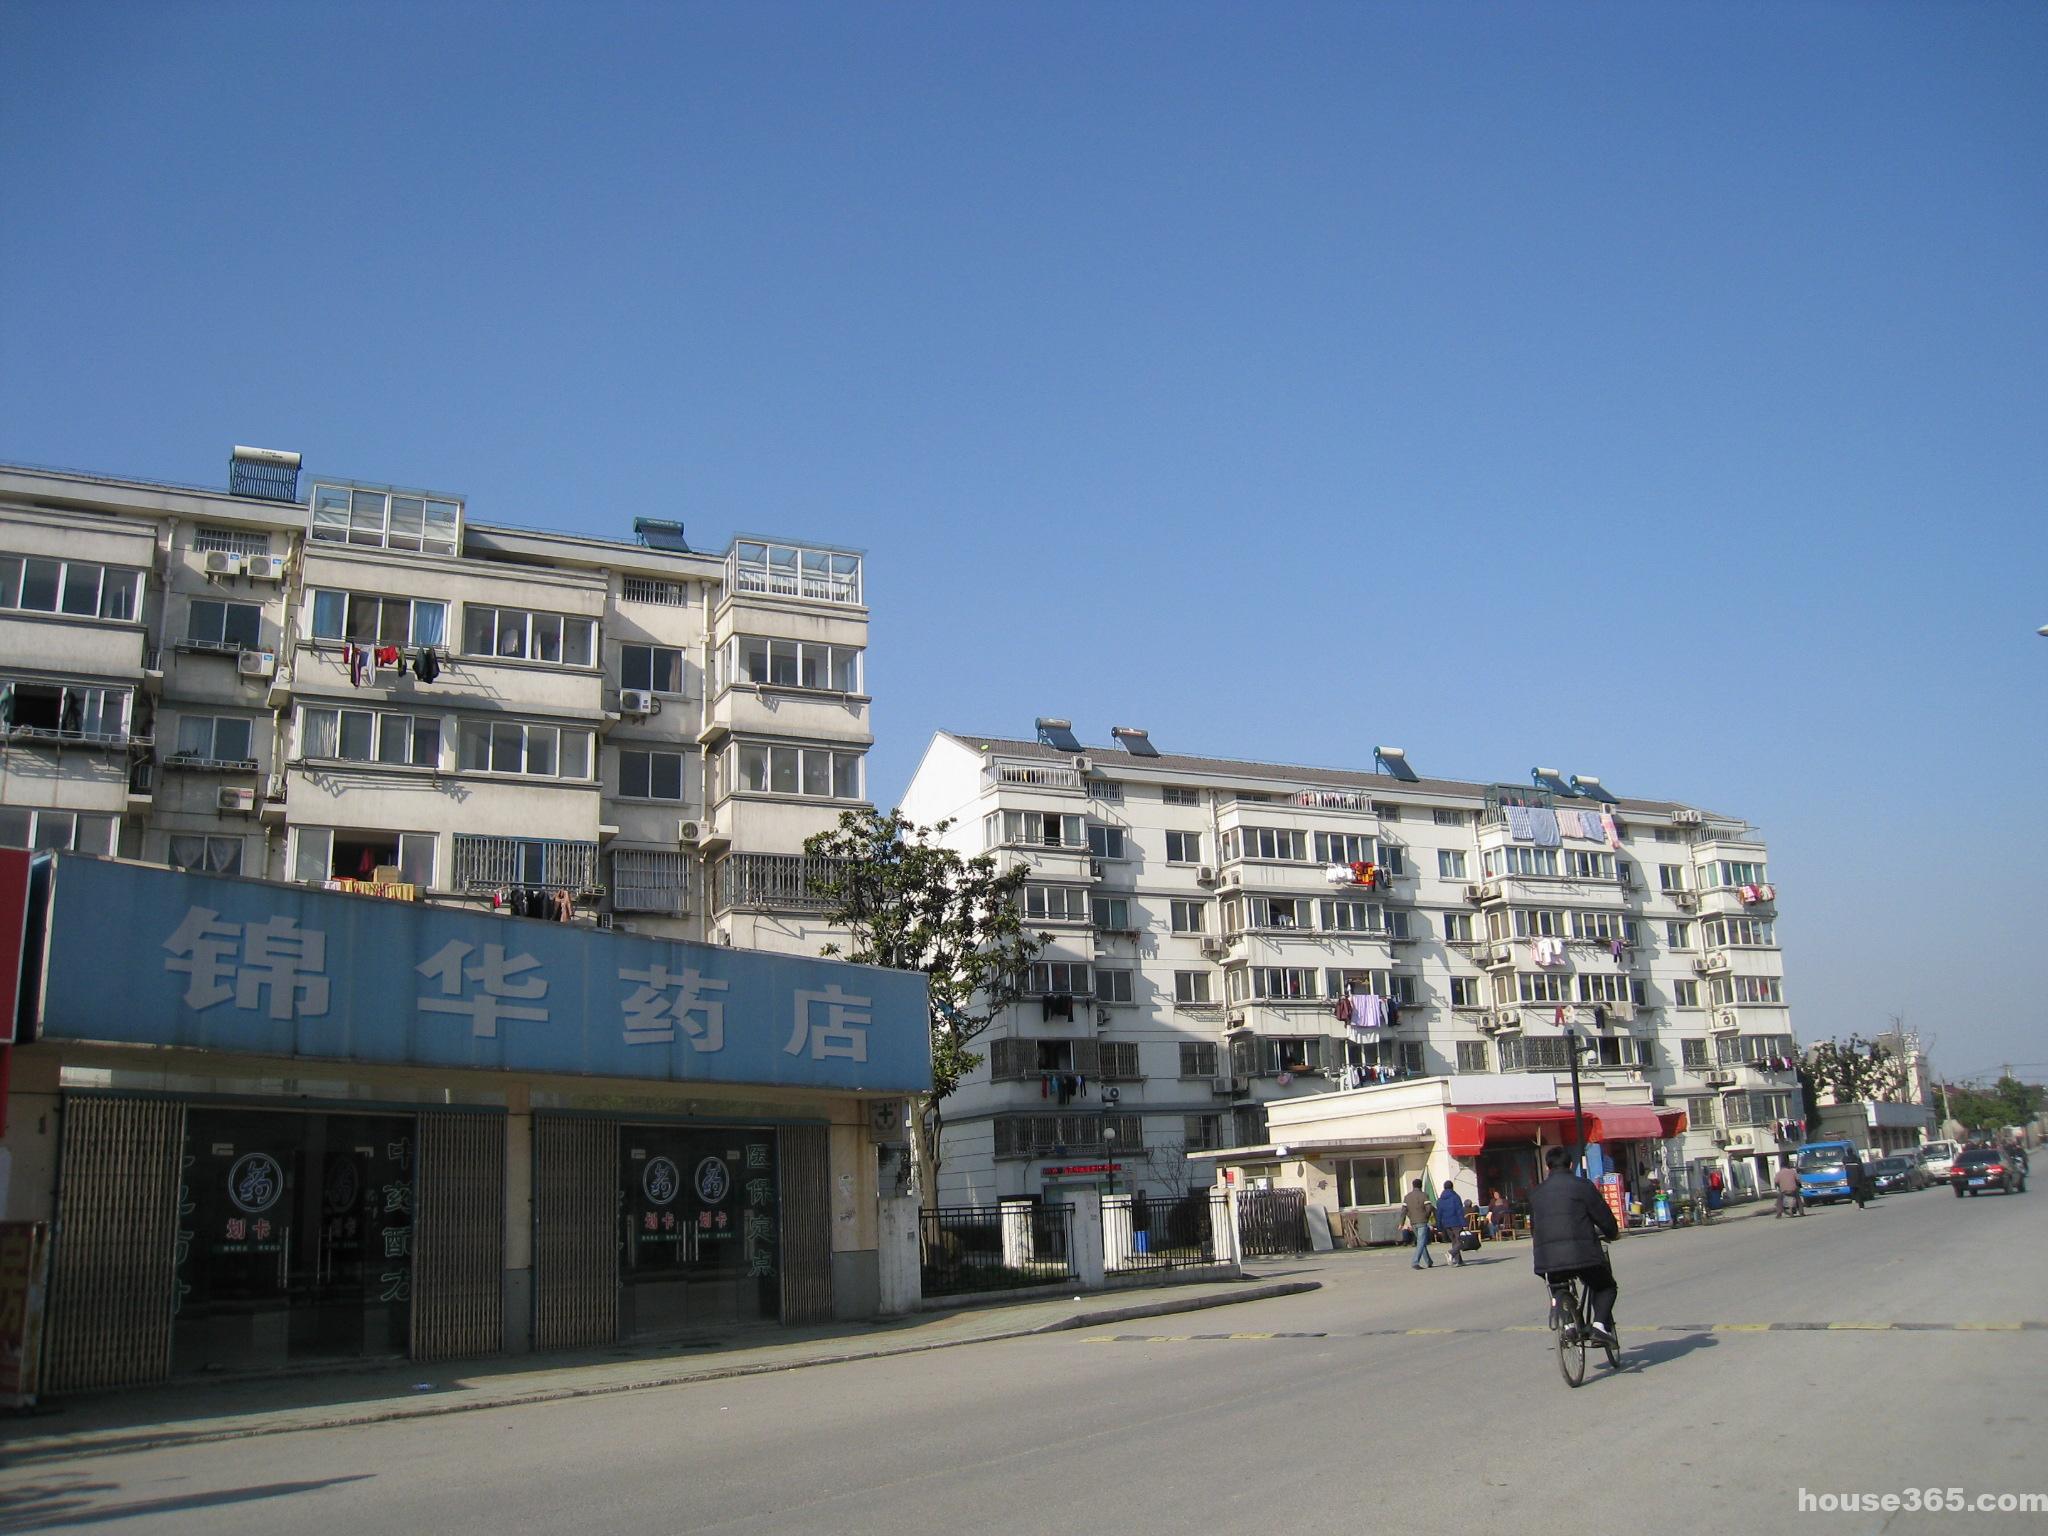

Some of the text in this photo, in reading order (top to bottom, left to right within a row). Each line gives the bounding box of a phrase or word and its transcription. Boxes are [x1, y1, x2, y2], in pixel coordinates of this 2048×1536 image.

[162, 904, 873, 1064] 锦华药店
[226, 1217, 272, 1240] 划卡
[745, 1143, 777, 1277] 医保定点
